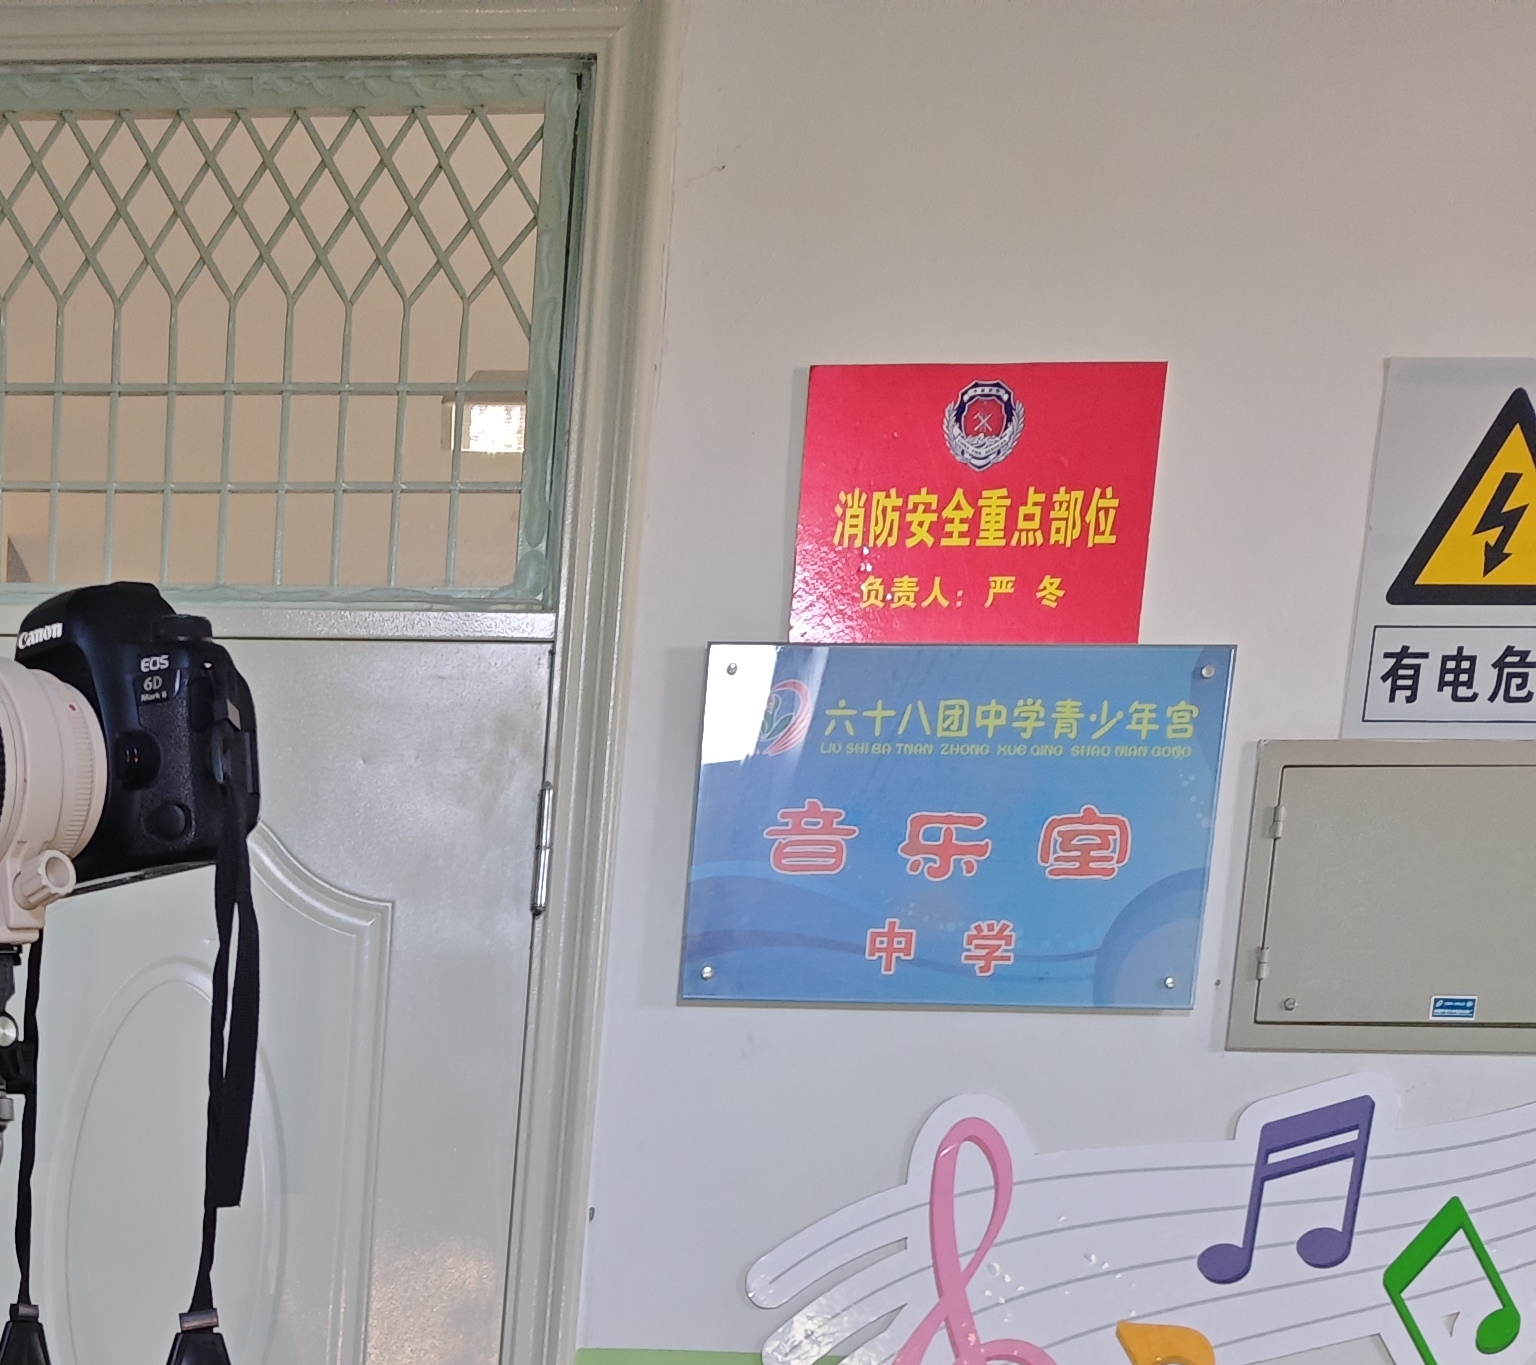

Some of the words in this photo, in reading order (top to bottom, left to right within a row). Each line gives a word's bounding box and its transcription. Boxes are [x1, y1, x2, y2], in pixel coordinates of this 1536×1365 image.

[832, 486, 1120, 549] 消防安全重点部位
[18, 622, 64, 649] Canon
[140, 654, 169, 673] EOS
[143, 676, 163, 692] 6D
[1379, 644, 1536, 704] 有电危
[824, 698, 1200, 741] 六十八团中学青少年宫
[820, 742, 842, 754] LIU
[846, 742, 869, 755] SHI
[871, 743, 892, 755] BA
[940, 743, 990, 756] ZHONG
[997, 744, 1027, 756] XUE
[1070, 745, 1112, 756] SHAO
[763, 798, 1132, 881] 音乐室
[865, 918, 1015, 977] 中学
